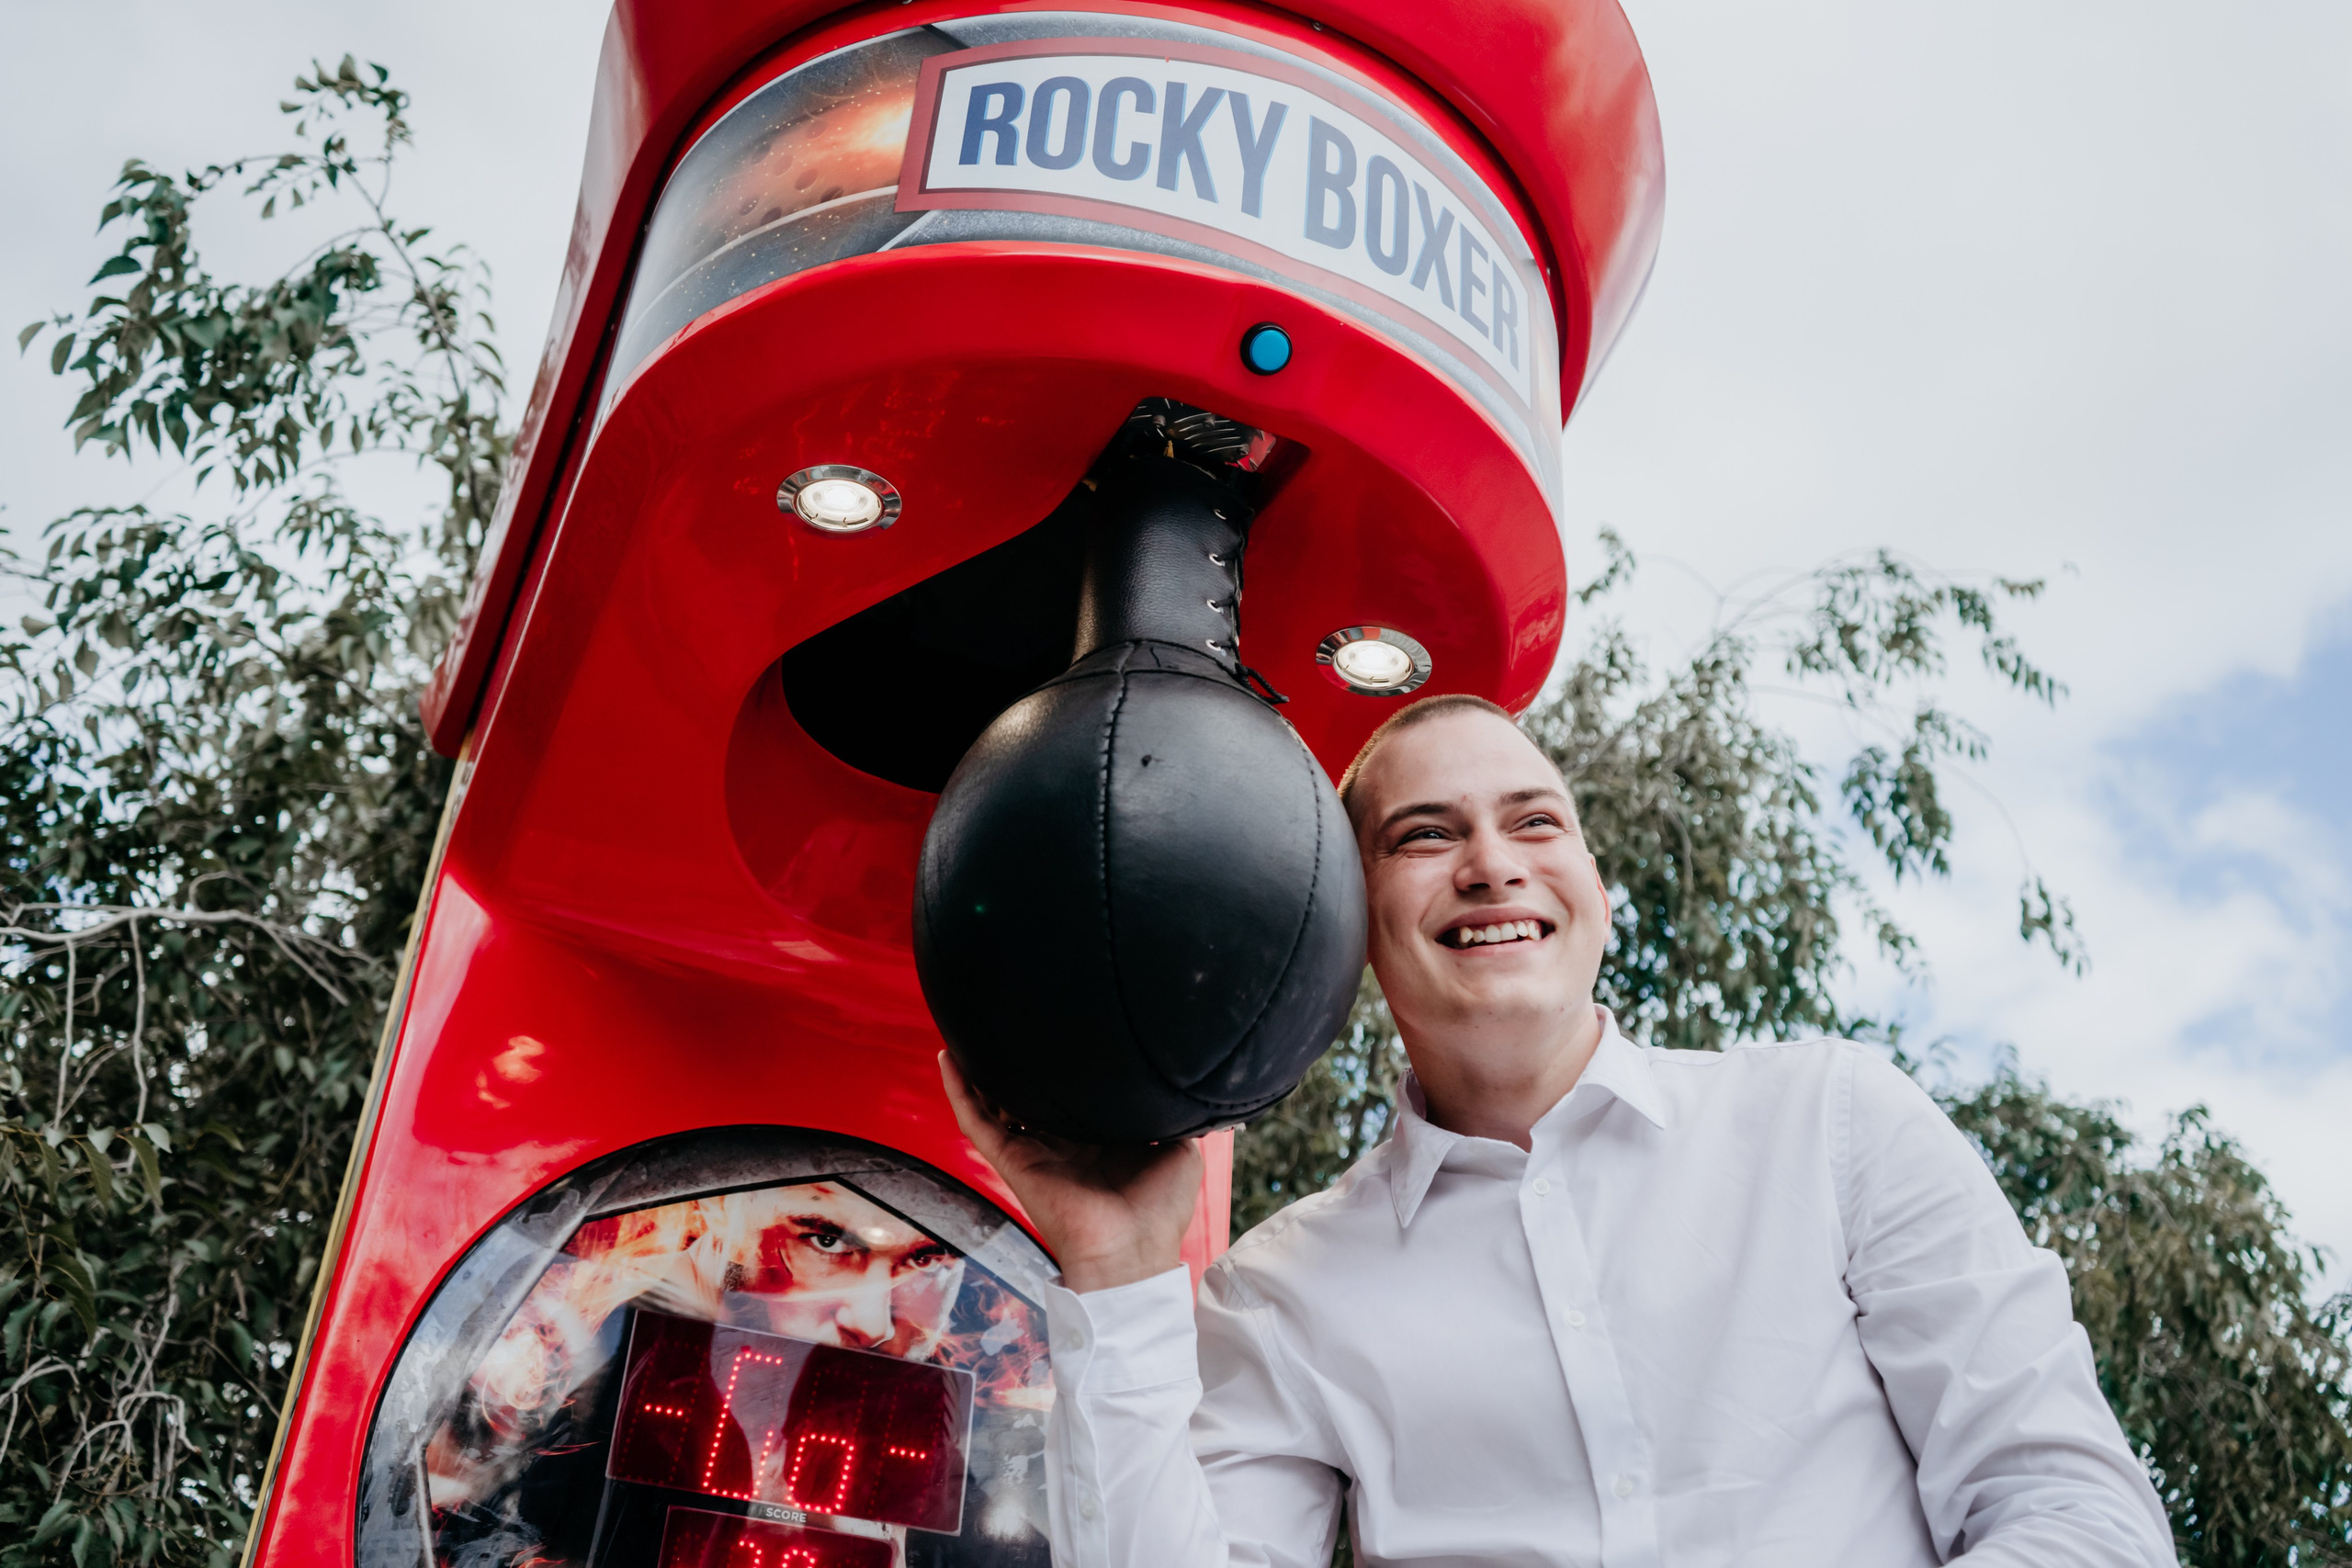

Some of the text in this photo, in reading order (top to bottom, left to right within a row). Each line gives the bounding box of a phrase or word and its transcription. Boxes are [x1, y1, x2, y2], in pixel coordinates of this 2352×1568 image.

[958, 75, 1520, 373] ROCKY BOXER
[764, 1506, 808, 1524] SCORE
